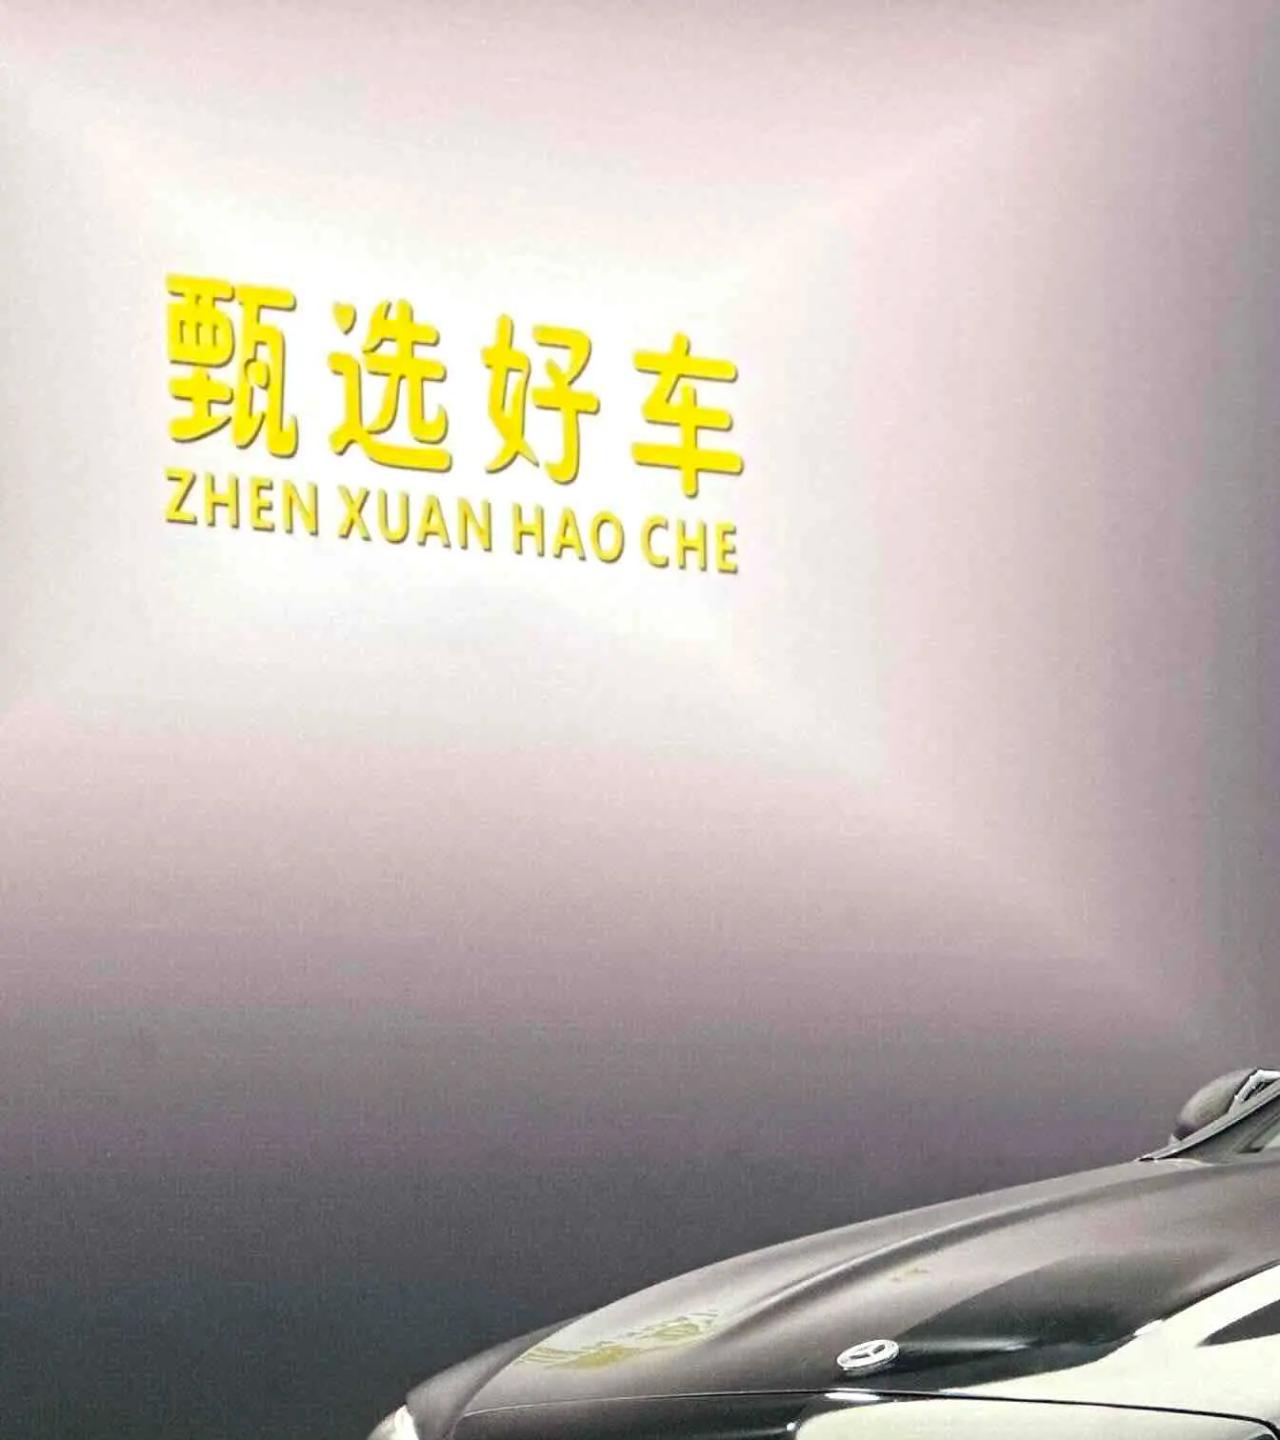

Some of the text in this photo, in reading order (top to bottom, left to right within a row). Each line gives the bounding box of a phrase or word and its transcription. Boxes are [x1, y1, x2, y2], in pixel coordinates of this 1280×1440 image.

[165, 274, 743, 498] 甄选好车
[164, 467, 738, 574] ZHEN XUAN HAO CHE
